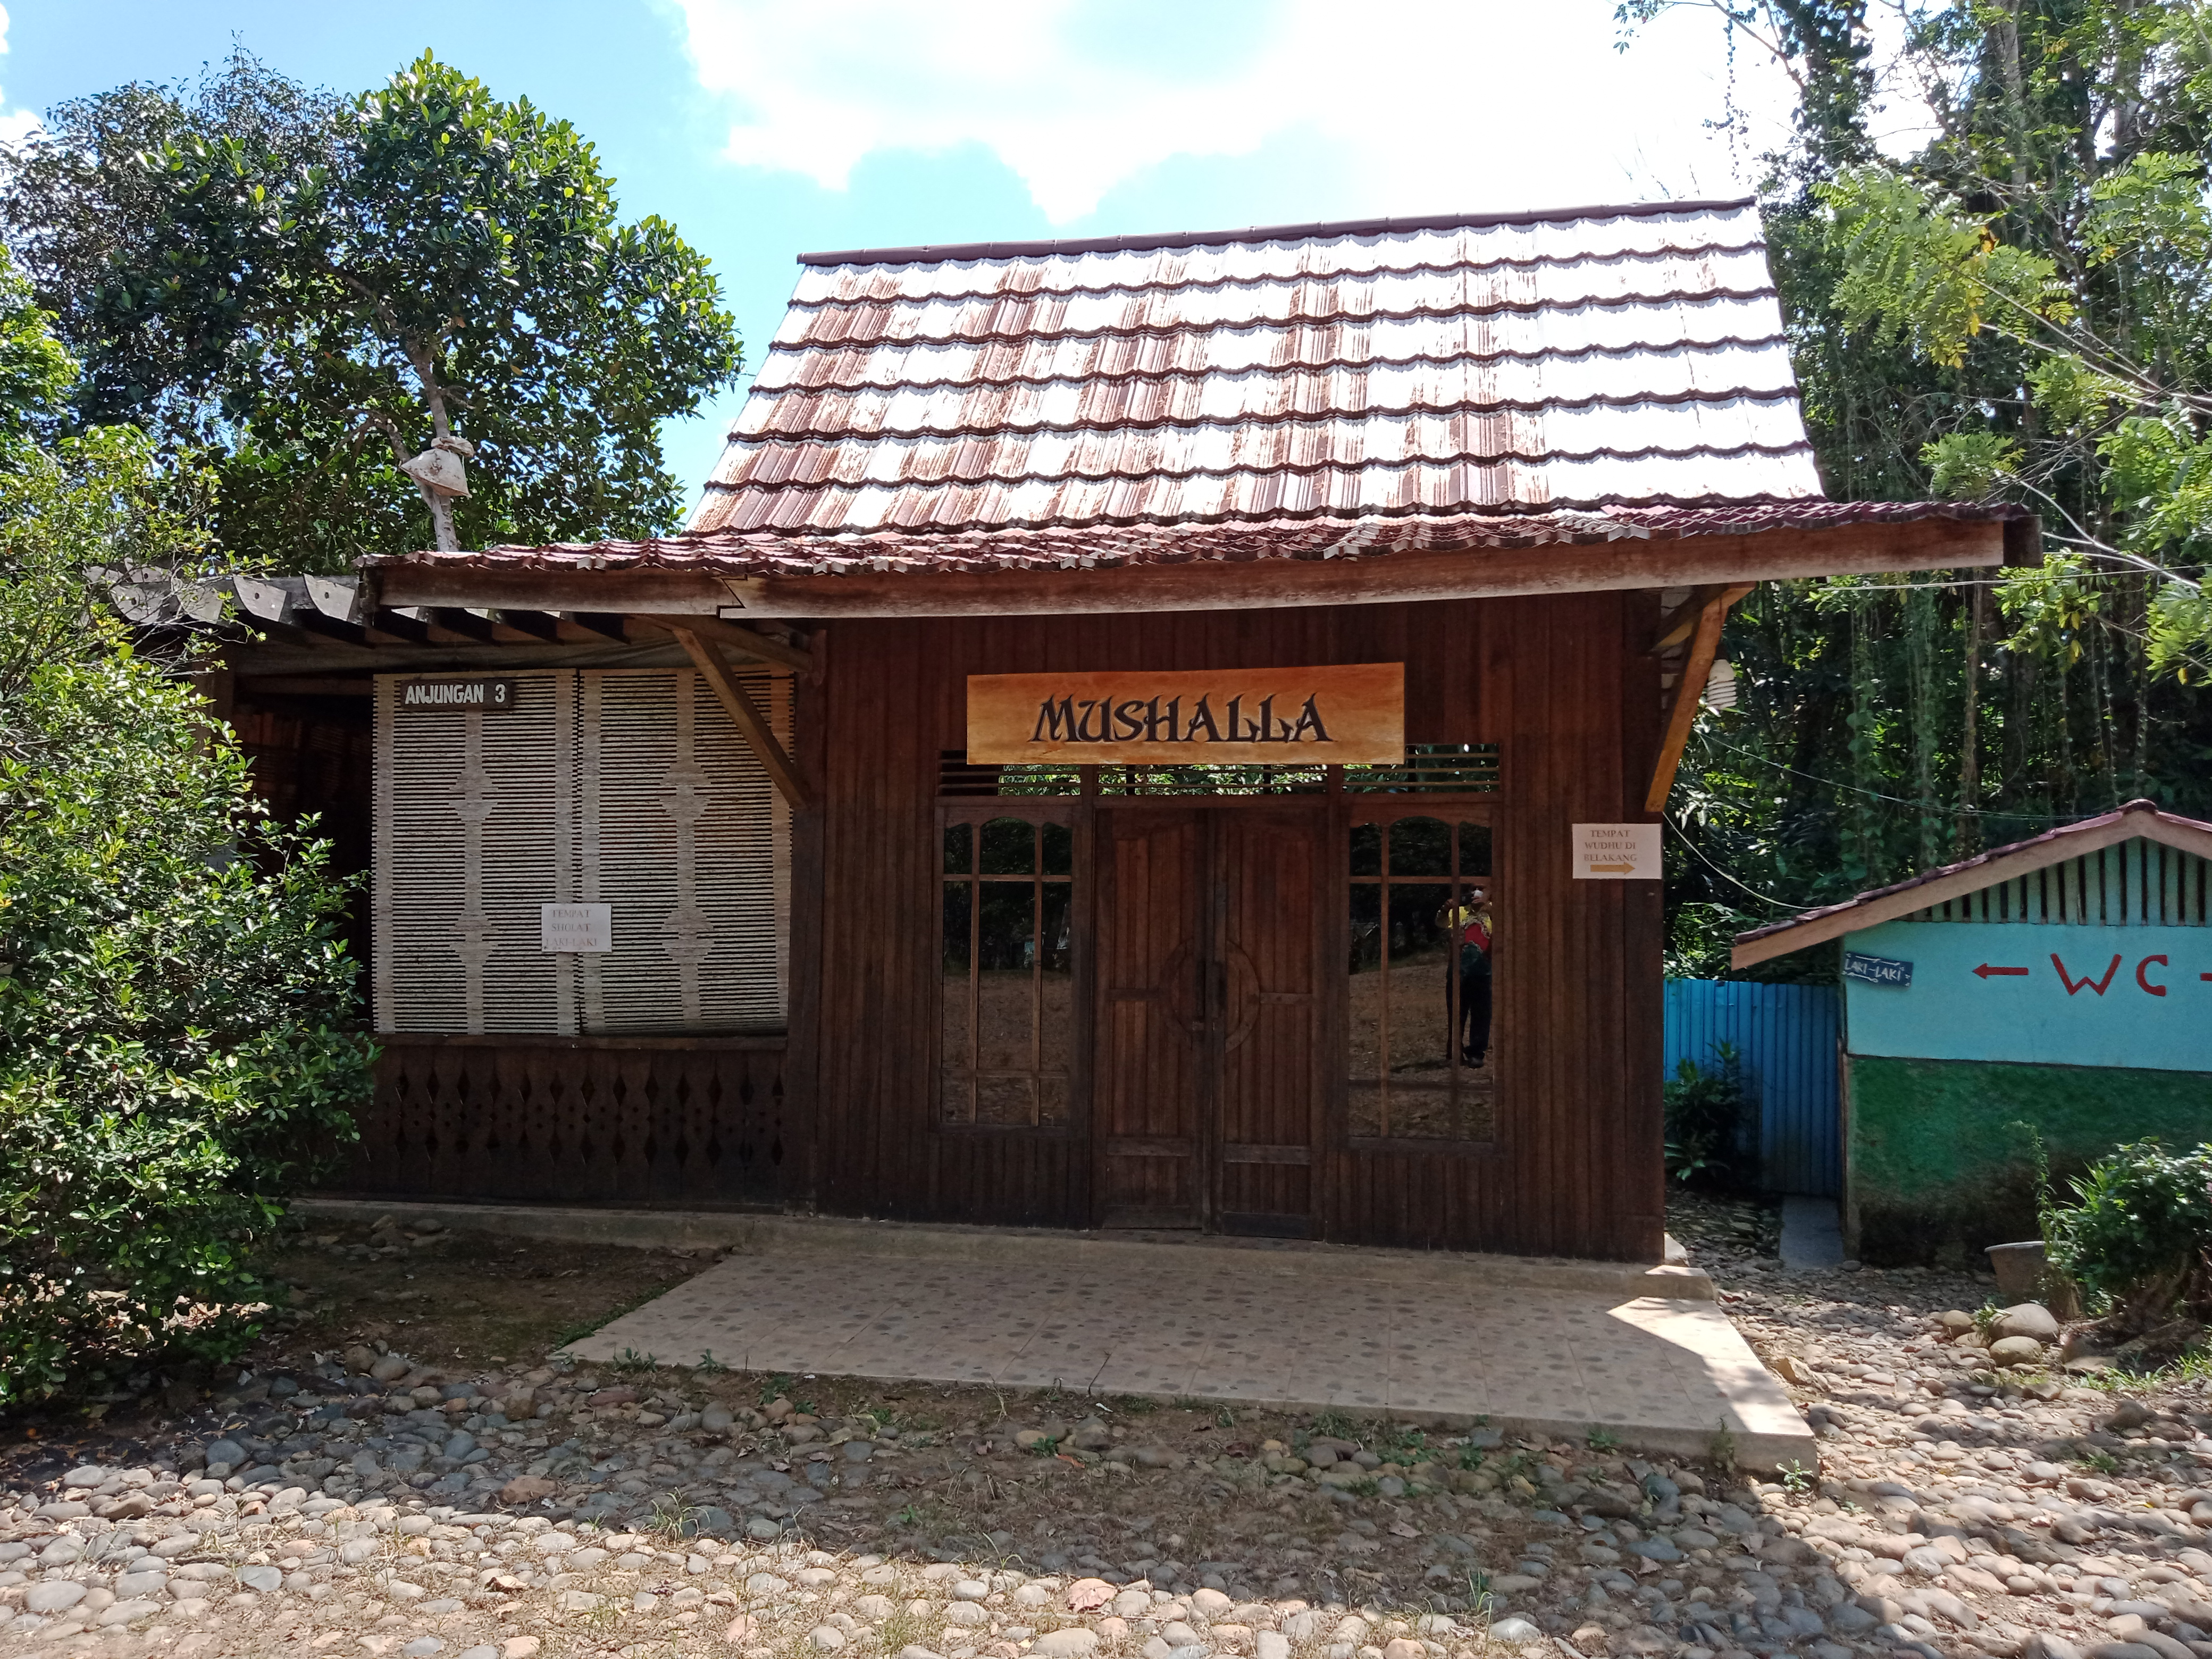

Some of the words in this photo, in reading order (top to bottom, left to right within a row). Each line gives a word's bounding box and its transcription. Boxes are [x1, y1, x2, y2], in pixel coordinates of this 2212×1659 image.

[405, 684, 484, 705] ANJUNGAN
[495, 683, 506, 703] 3
[1027, 691, 1338, 743] MUSHALLA
[1589, 830, 1631, 838] TEMPAT
[1584, 853, 1637, 862] BELAKANG
[550, 909, 591, 918] TEMPAT
[551, 923, 591, 932] SHOLAT
[545, 937, 597, 946] LAKI-LAKI
[1844, 958, 1901, 982] LAKI-LAKI
[2050, 952, 2168, 997] WC
